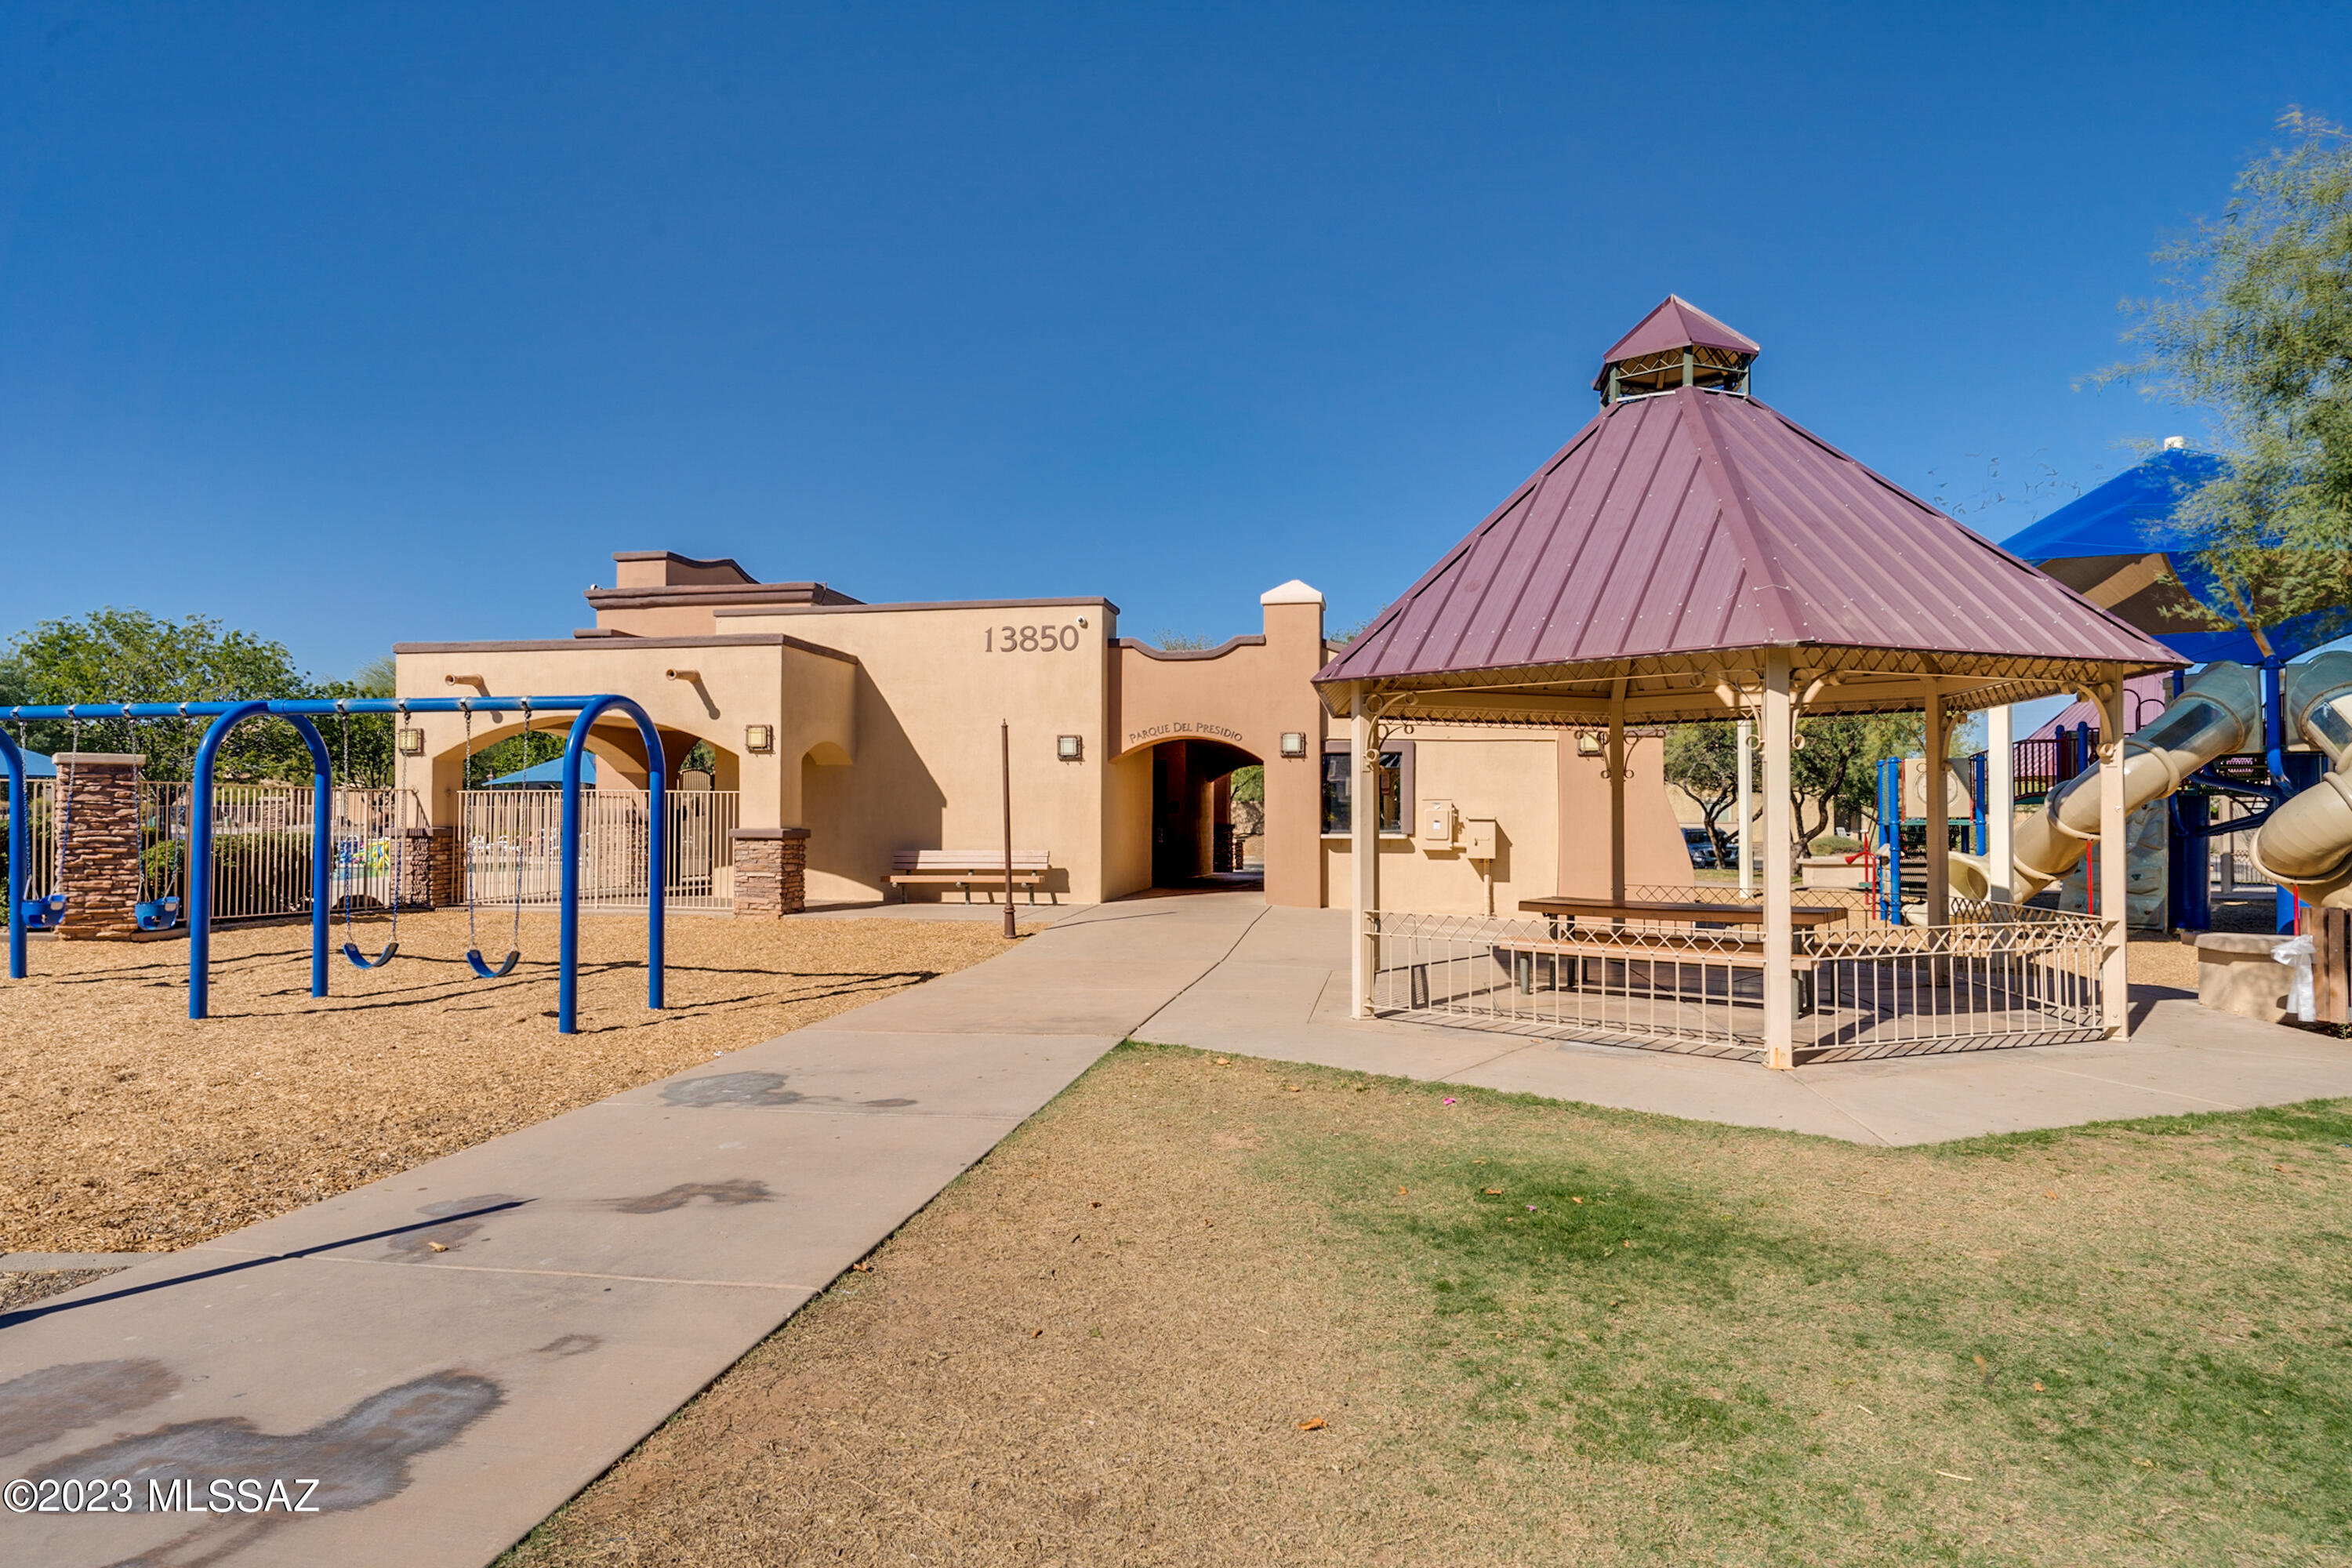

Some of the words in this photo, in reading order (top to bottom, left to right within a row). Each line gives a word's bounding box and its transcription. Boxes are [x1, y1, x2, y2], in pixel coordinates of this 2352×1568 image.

[985, 625, 1080, 652] 13850
[1129, 724, 1171, 743] PARQUE
[1173, 722, 1192, 732] DEL
[1196, 722, 1243, 742] PRESIDIO
